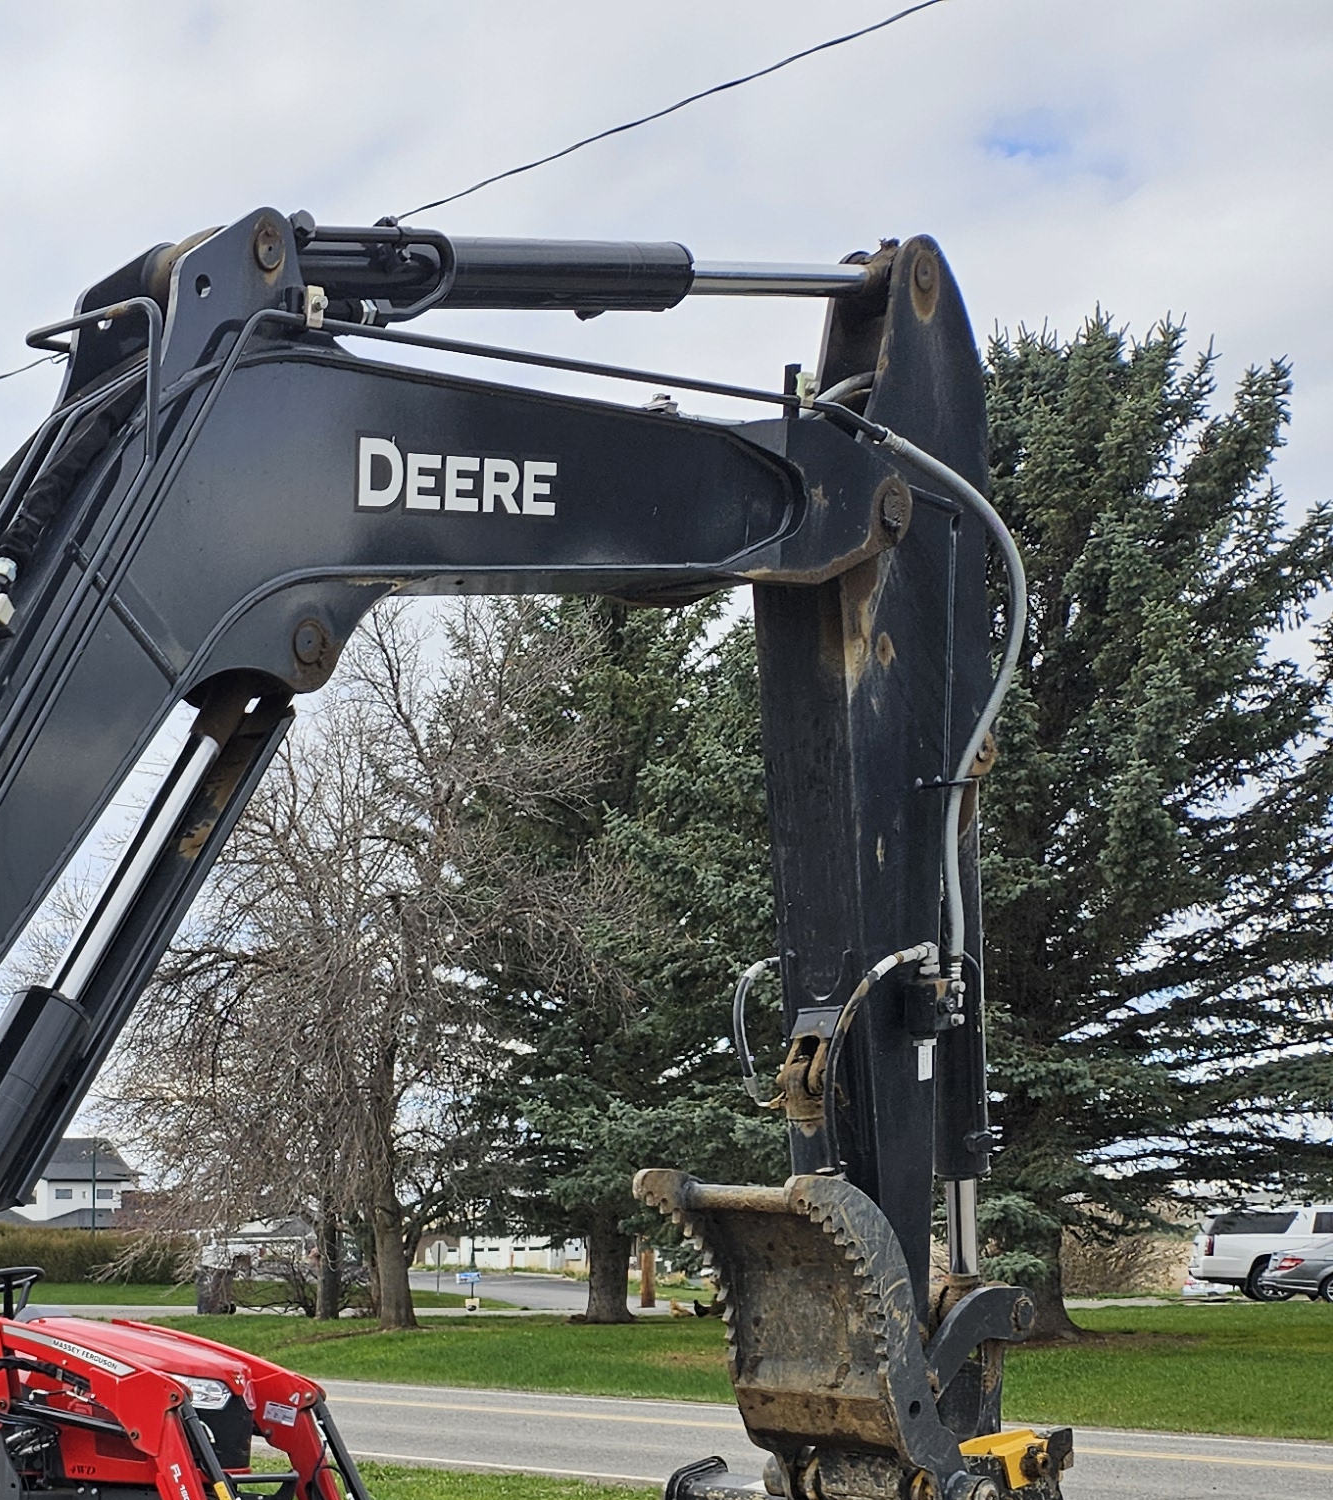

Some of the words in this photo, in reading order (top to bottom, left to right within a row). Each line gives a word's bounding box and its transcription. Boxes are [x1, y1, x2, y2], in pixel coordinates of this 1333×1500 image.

[358, 436, 558, 516] DEERE
[52, 1339, 81, 1354] MASSEY
[81, 1350, 118, 1370] FERGUSON
